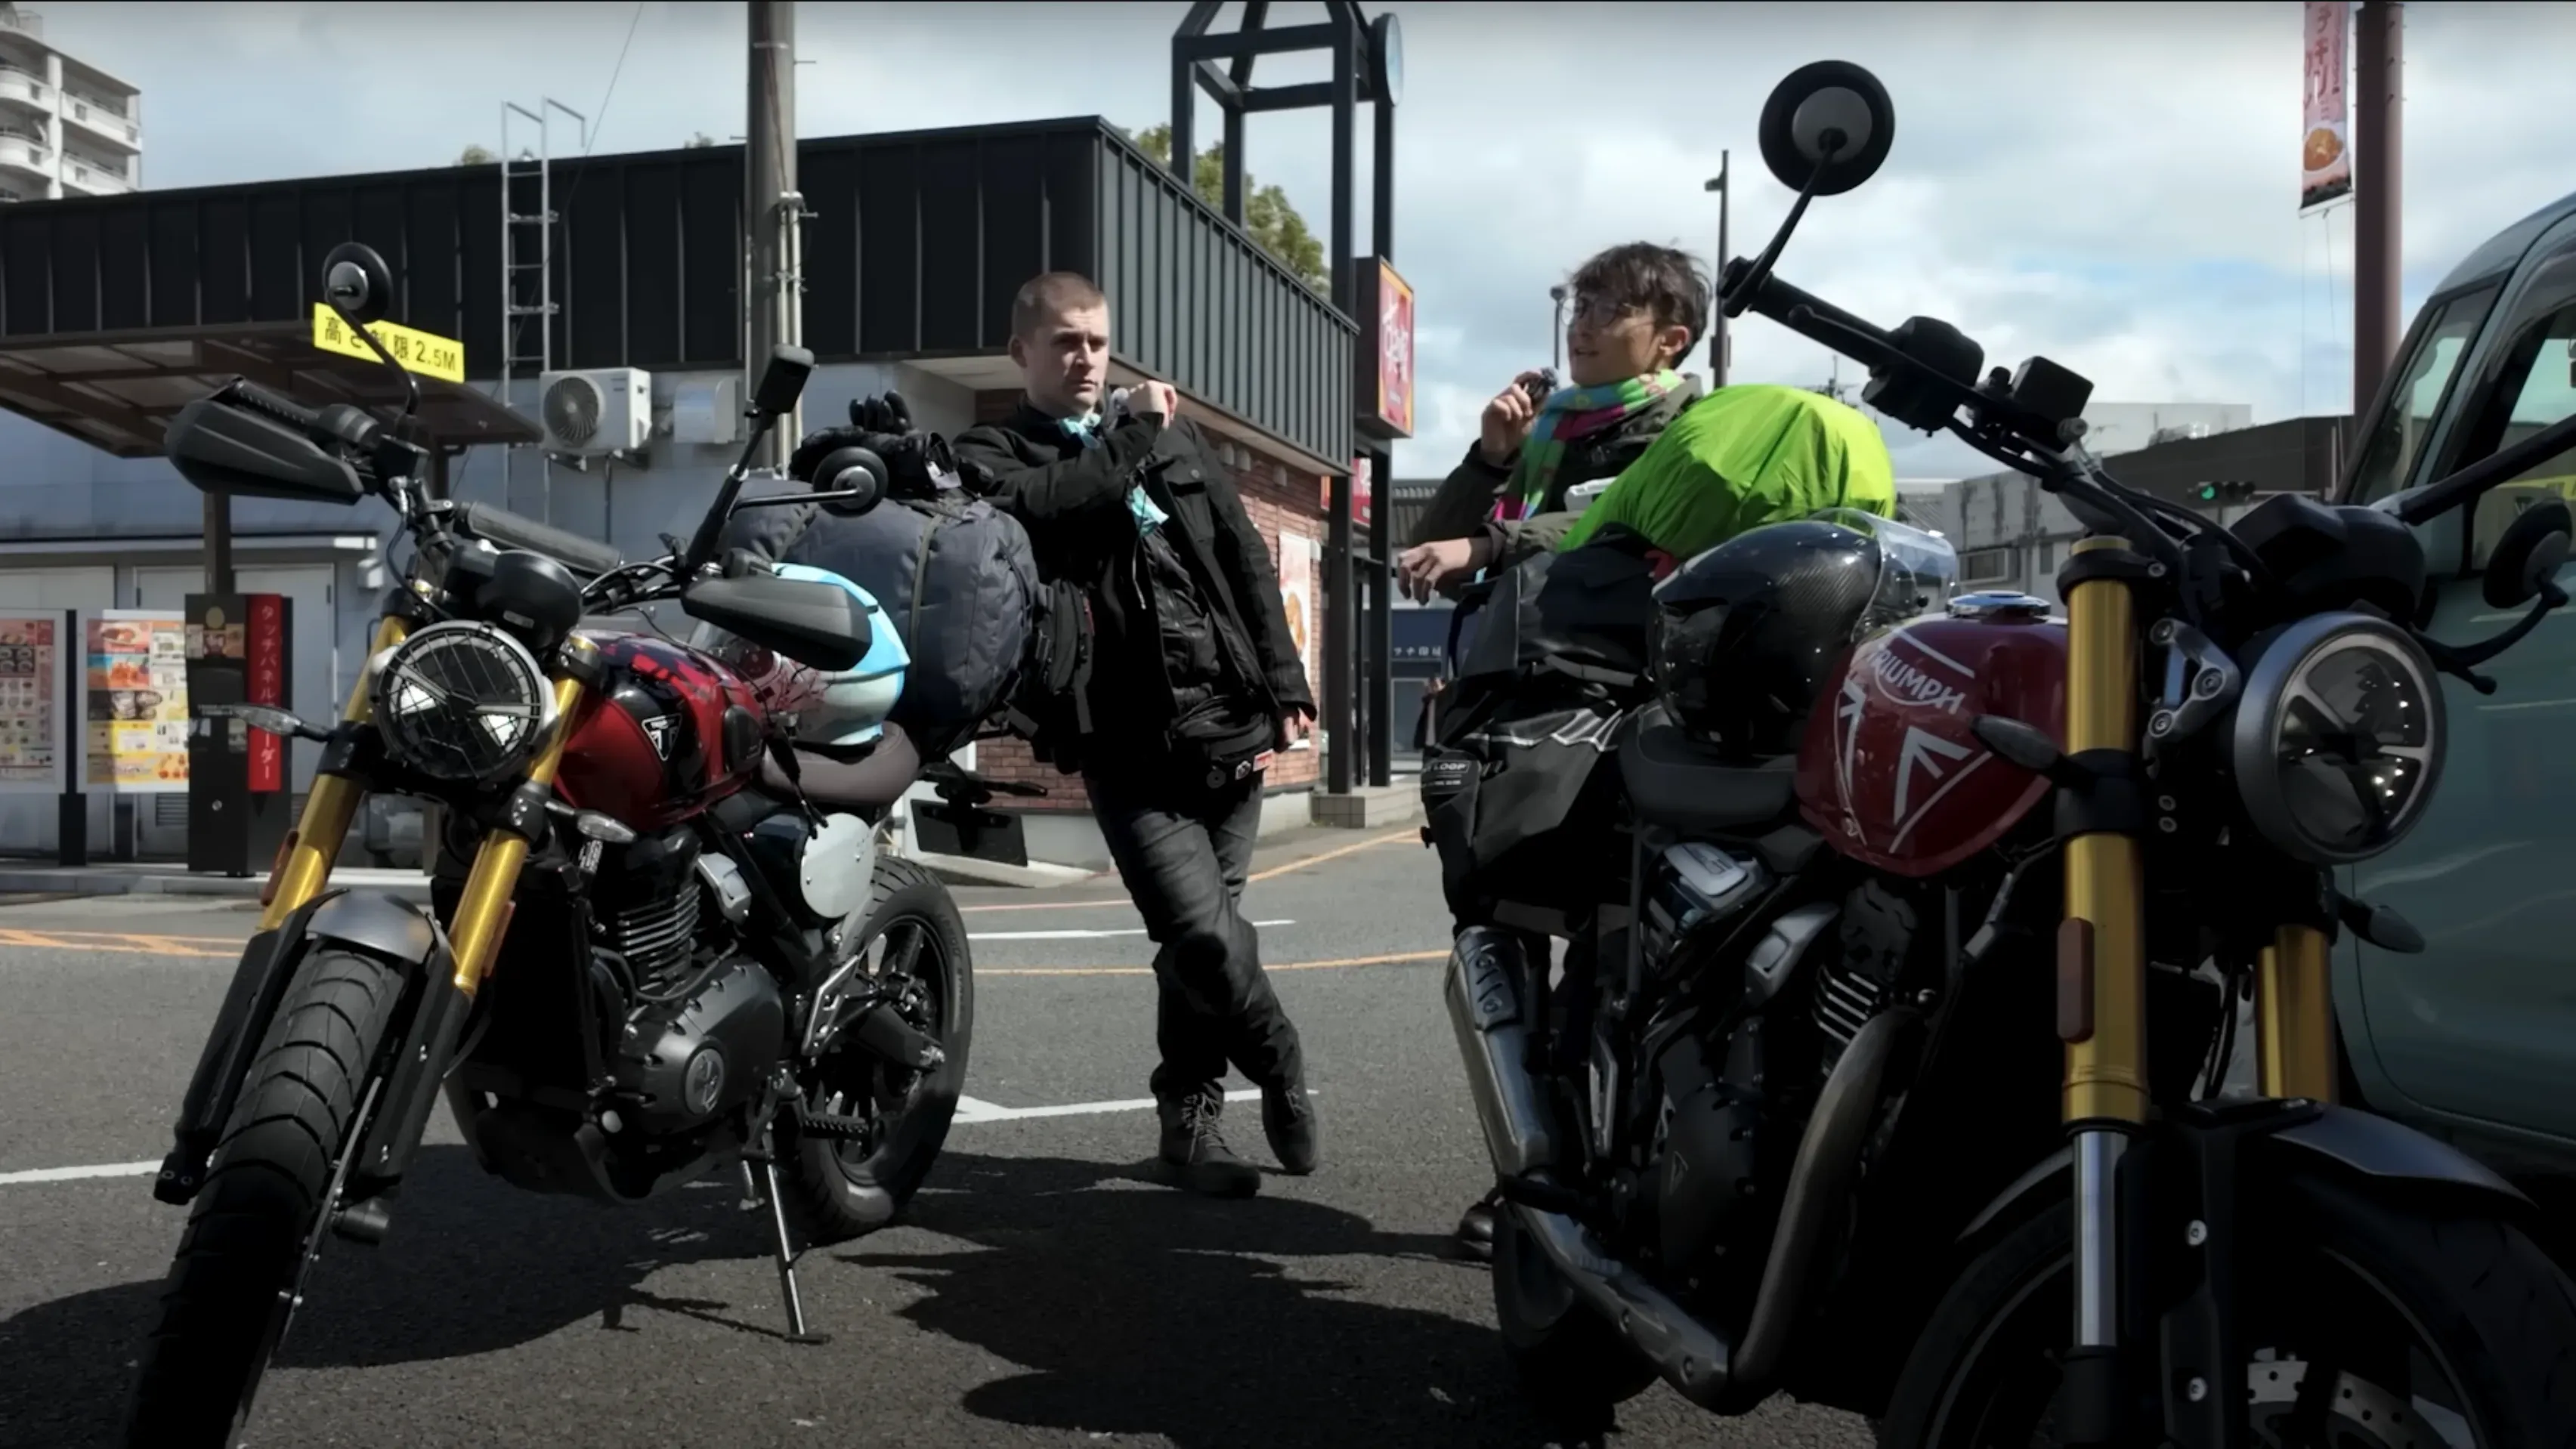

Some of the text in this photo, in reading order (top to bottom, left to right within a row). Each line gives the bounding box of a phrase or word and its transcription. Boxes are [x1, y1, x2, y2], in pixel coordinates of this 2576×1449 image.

[260, 605, 277, 780] タッチパネルーダー
[1866, 643, 1966, 715] TRIUMPH
